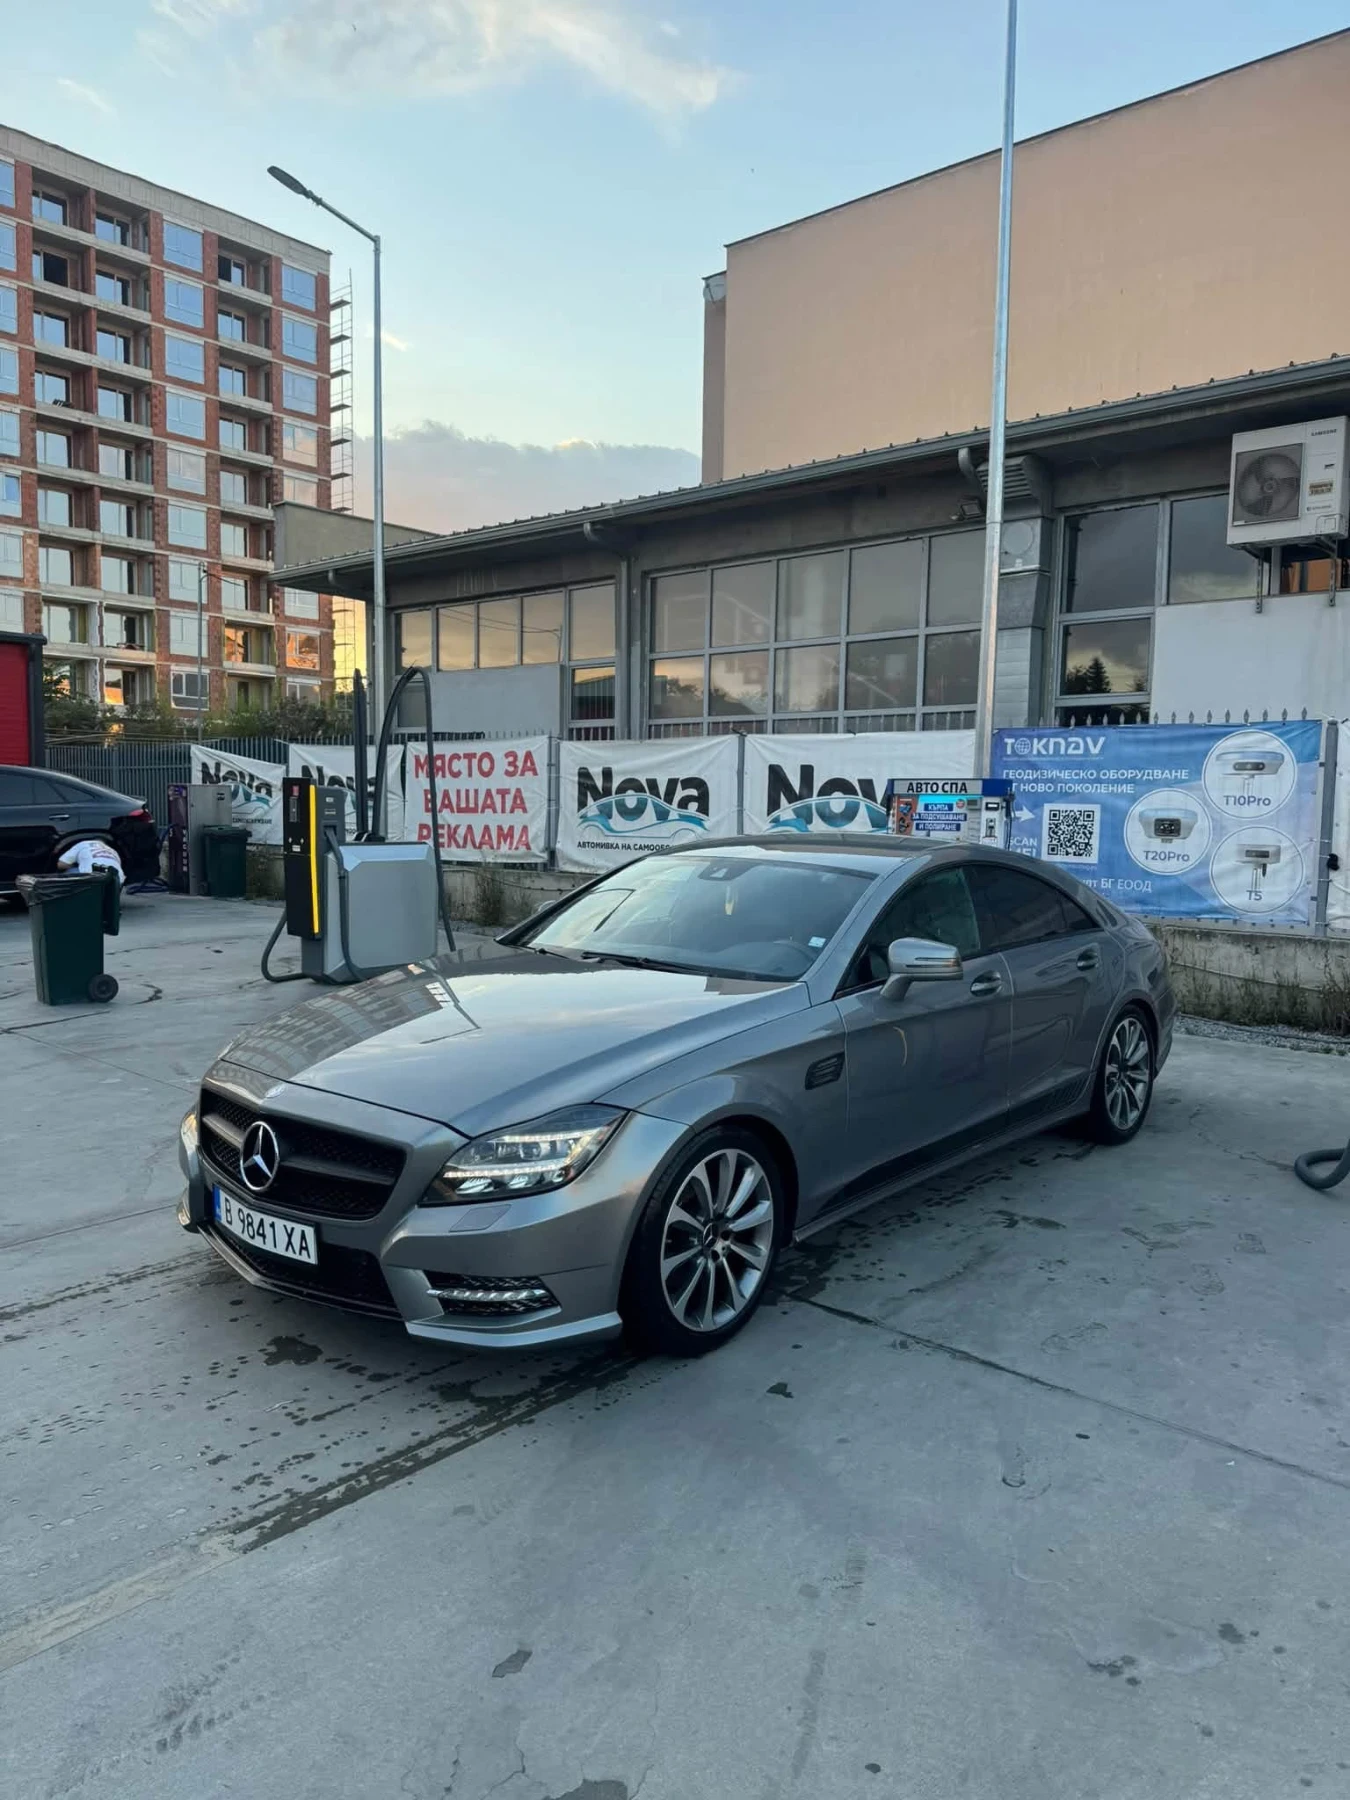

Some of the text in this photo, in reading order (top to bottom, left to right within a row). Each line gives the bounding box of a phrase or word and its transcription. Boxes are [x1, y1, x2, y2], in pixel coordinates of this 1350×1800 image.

[414, 750, 538, 779] МЯСТО ЗА
[1101, 769, 1189, 781] ОБОРУДВАНЕ
[577, 767, 709, 821] Nova
[907, 782, 968, 793] АВТО СПА
[1020, 783, 1055, 793] НОВО
[1058, 783, 1135, 794] ПОКОЛЕНИЕ
[423, 788, 528, 814] ВАШАТА
[767, 764, 888, 828] Nov
[1223, 795, 1271, 807] T10Pro
[417, 823, 532, 851] РЕКЛАМА
[621, 843, 632, 851] НА
[1143, 850, 1190, 862] T20Pro
[1101, 878, 1115, 889] БГ
[1117, 879, 1152, 893] ЕООД
[1246, 890, 1263, 901] T5
[225, 1197, 232, 1226] B
[238, 1208, 277, 1249] 9841
[283, 1224, 311, 1260] XA
